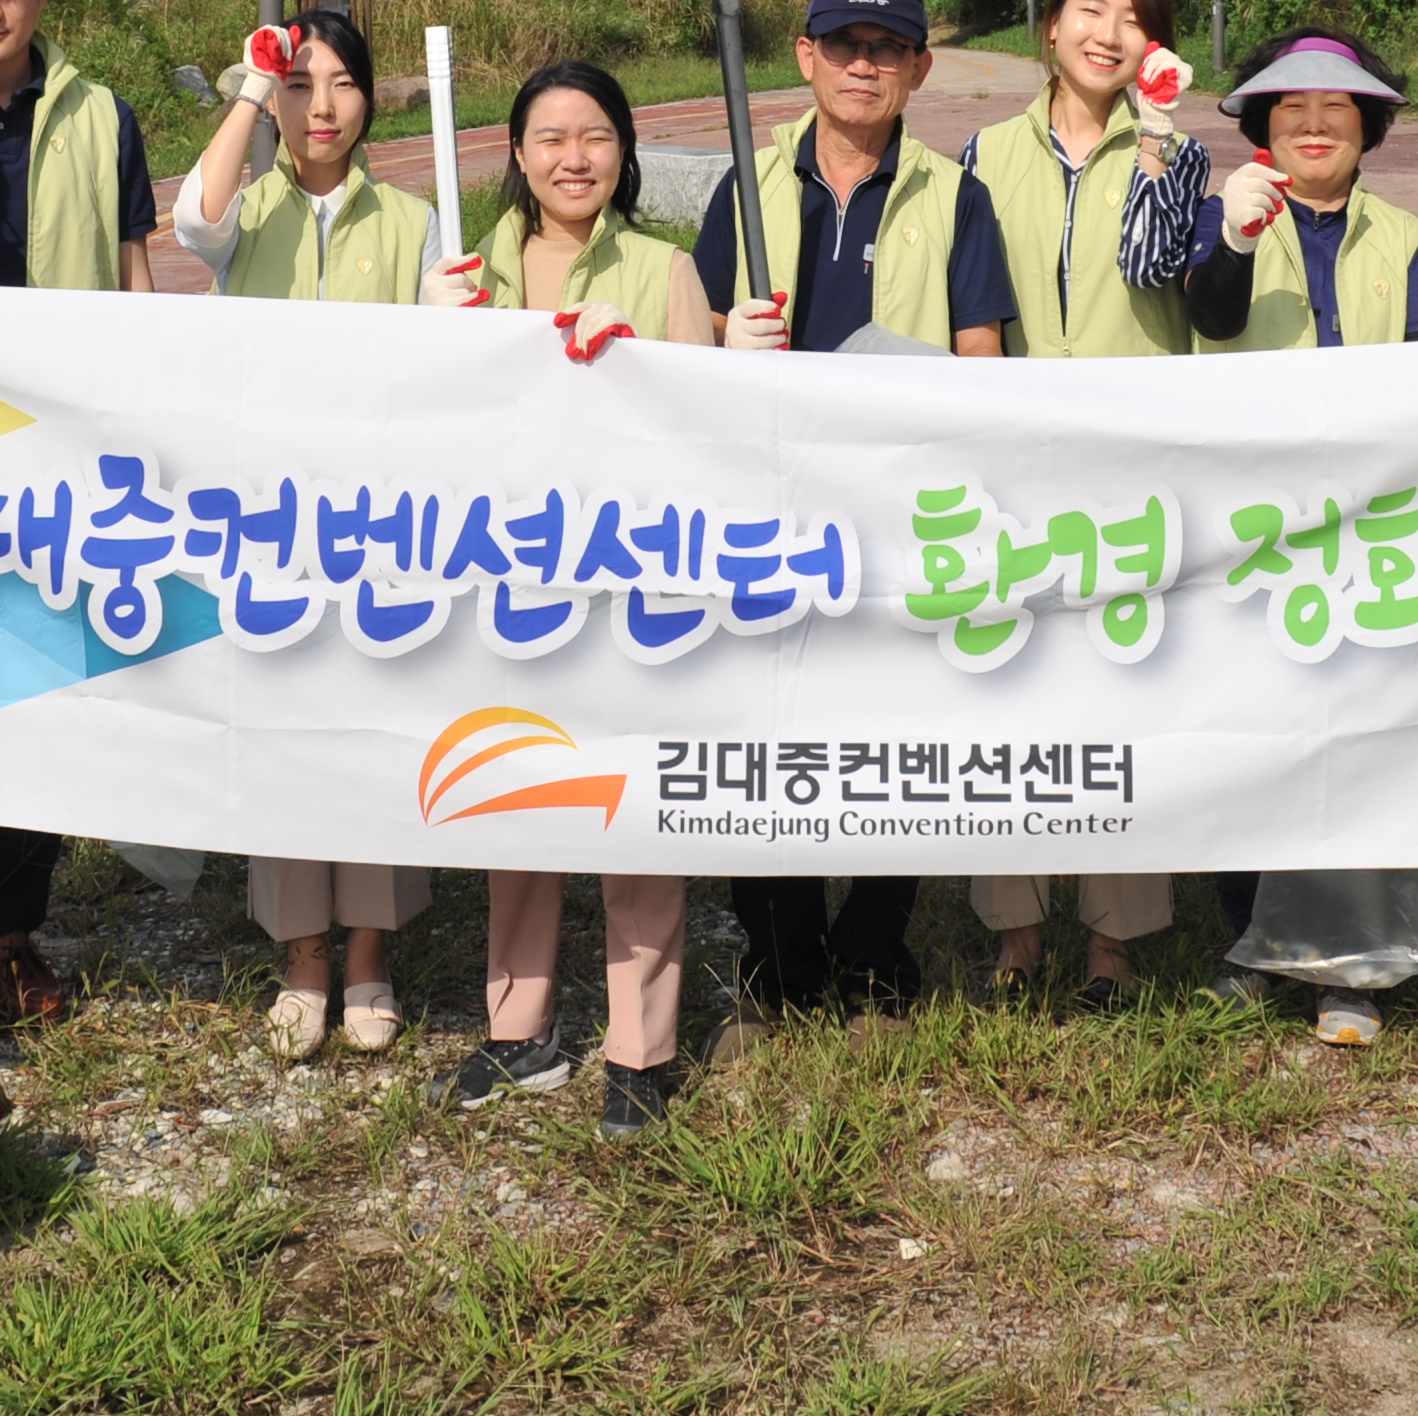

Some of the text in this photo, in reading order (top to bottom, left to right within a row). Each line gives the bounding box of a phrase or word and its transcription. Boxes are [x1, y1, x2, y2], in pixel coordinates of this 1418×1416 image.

[906, 484, 1166, 656] 환경
[657, 741, 1133, 805] 김대중컨벤션센터
[658, 809, 1133, 842] Kimdaejung Convention Center
